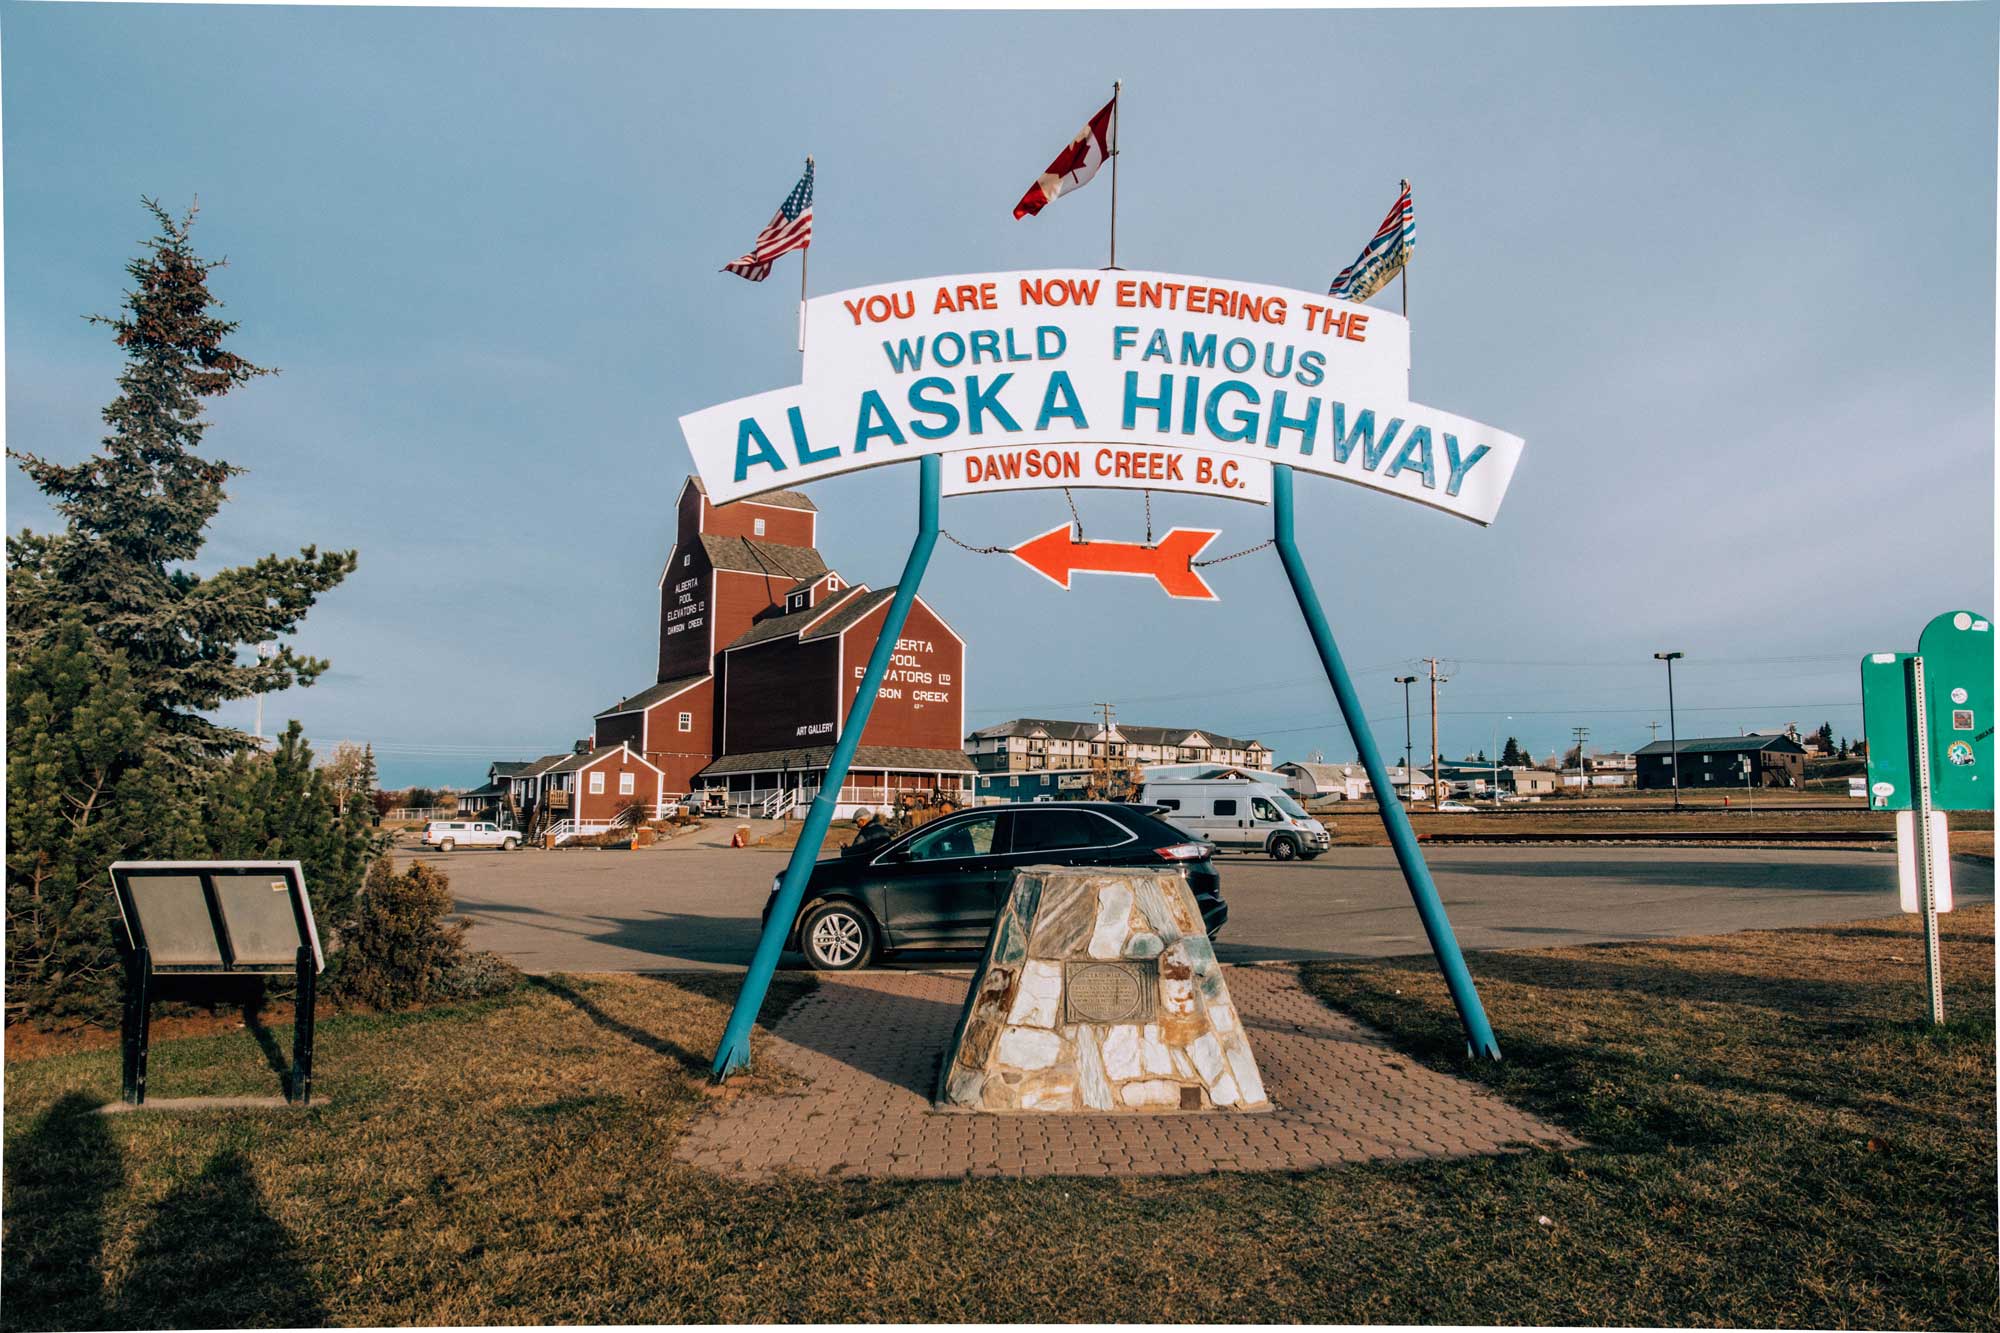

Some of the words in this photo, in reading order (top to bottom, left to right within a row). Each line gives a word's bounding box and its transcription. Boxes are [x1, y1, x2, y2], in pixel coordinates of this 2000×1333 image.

[844, 291, 915, 325] YOU
[933, 283, 998, 314] ARE
[1019, 279, 1100, 306] NOW
[1116, 280, 1287, 325] ENTERING
[1303, 303, 1369, 342] THE
[882, 325, 1067, 374] WORLD
[1113, 326, 1326, 387] FAMOUS
[733, 370, 1089, 483] ALASKA
[1121, 370, 1492, 497] HIGHWAY
[966, 449, 1080, 483] DAWSON
[1095, 449, 1184, 480] CREEK
[1196, 456, 1246, 488] B.C.
[675, 577, 698, 594] ALBERTA
[679, 593, 693, 604] POOL
[667, 603, 697, 621] ELEVATORS
[667, 623, 685, 635] DAWSON
[688, 617, 703, 629] CREEK
[855, 667, 932, 684] EVATORS
[913, 690, 949, 703] CREEK
[796, 726, 807, 736] ART
[808, 722, 834, 735] GALLERY
